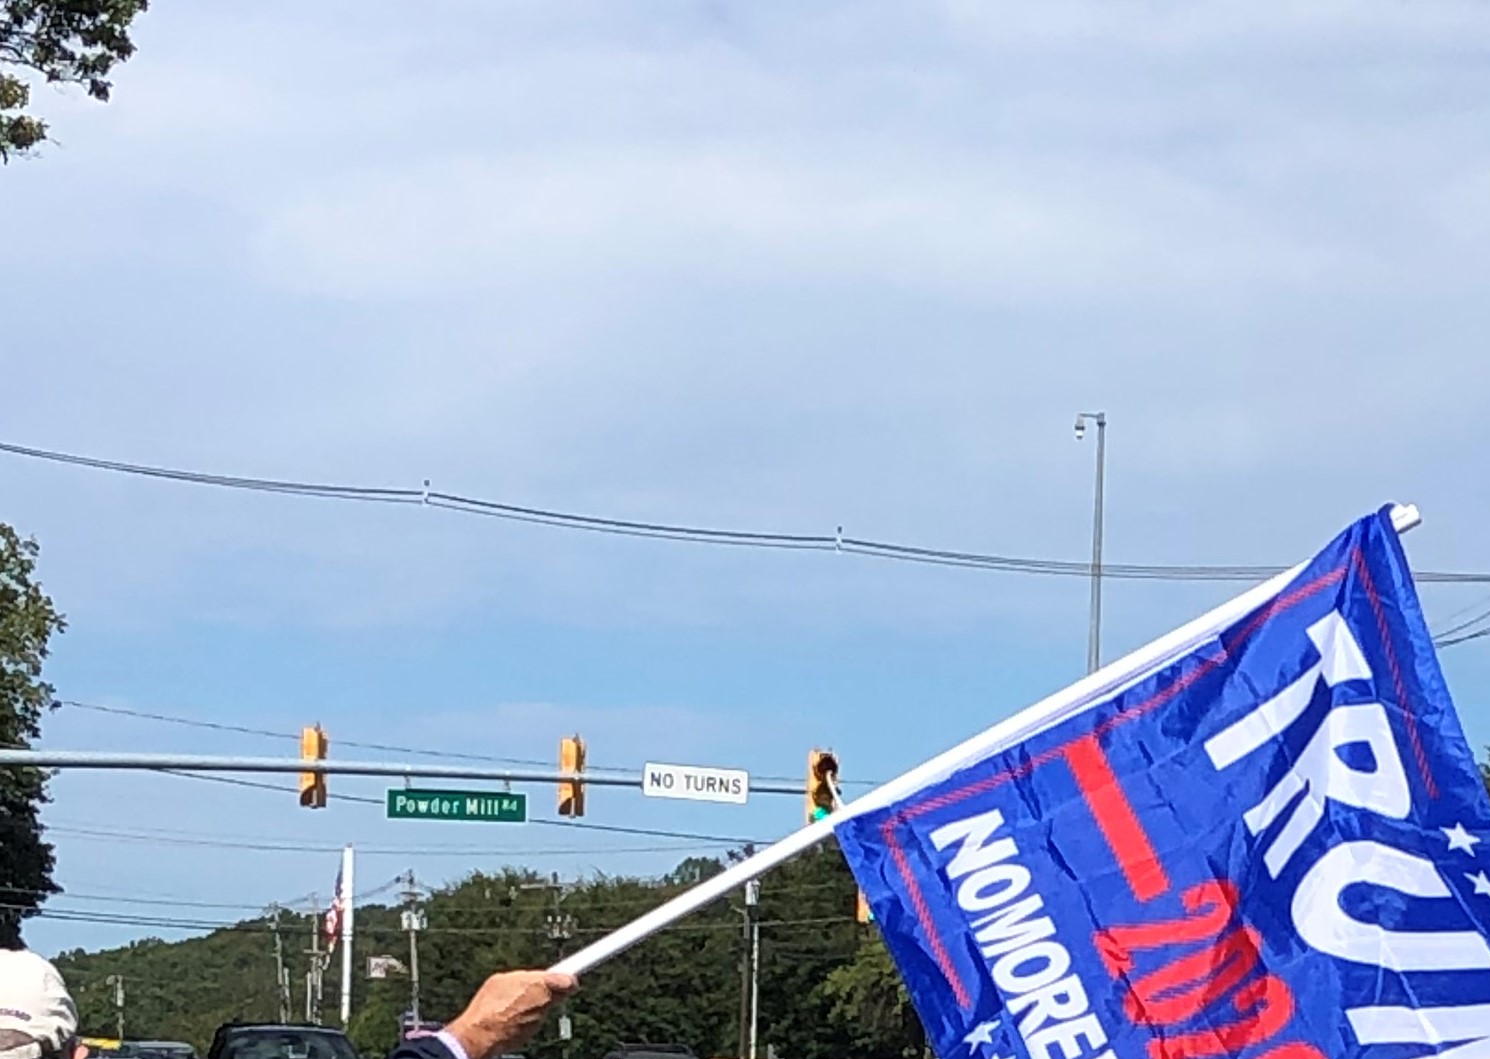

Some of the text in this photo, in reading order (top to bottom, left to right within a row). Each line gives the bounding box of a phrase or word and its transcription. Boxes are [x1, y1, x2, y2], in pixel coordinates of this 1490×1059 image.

[650, 771, 741, 795] NO TURNS
[396, 795, 517, 816] Powder Mill Rd
